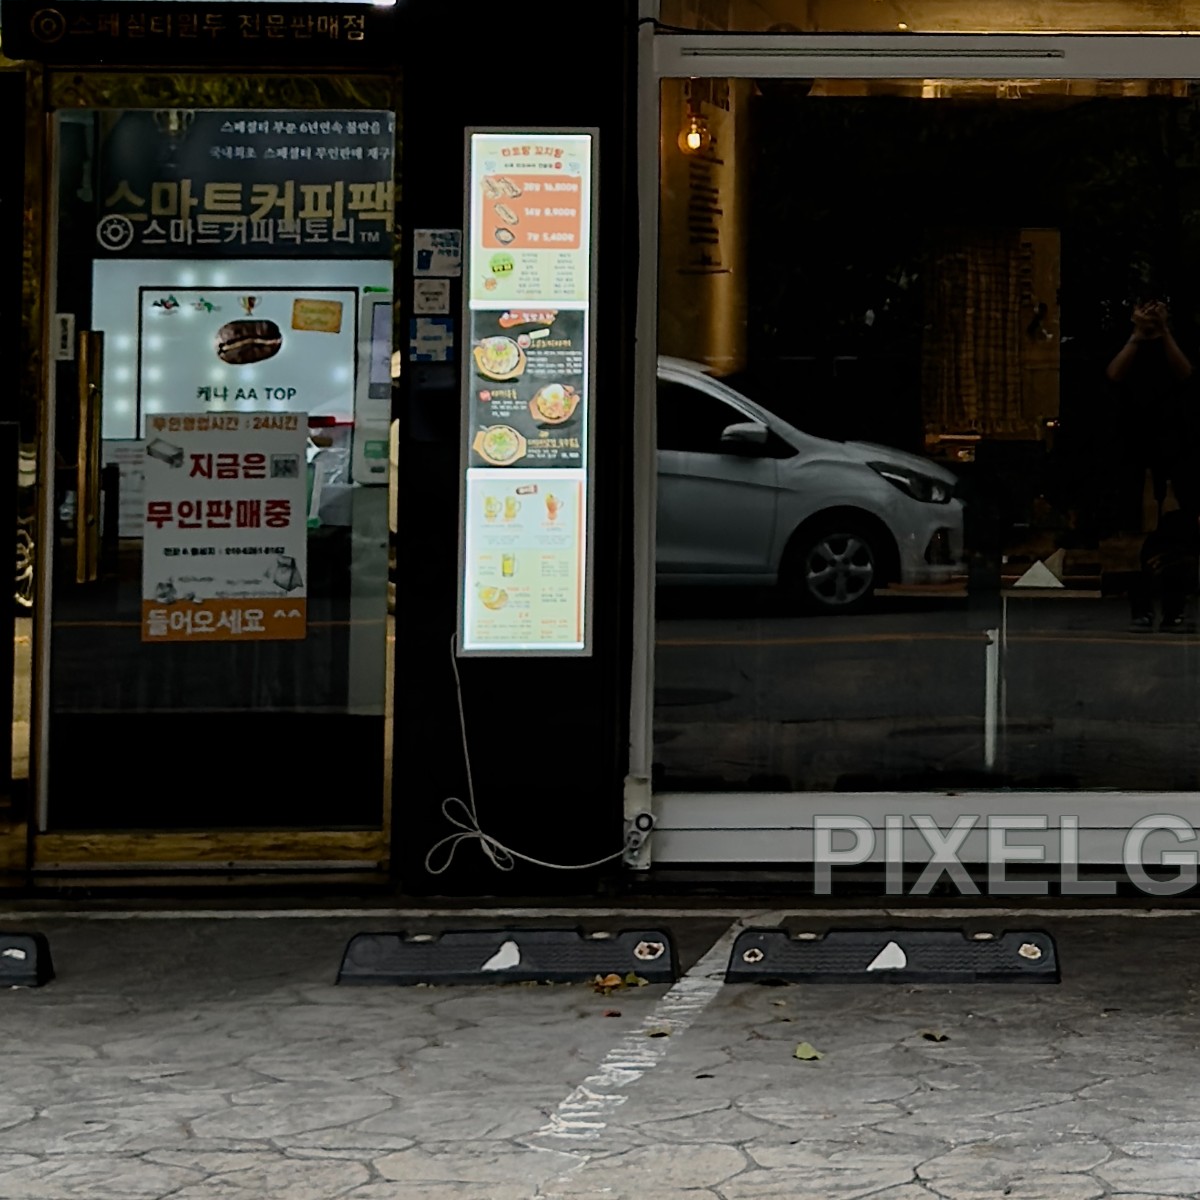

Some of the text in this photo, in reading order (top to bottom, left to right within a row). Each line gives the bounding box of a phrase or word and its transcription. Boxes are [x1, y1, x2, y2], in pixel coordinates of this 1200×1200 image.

[239, 13, 367, 40] 전문판매점
[104, 178, 395, 234] 스마트커피팩
[141, 217, 355, 245] 스마트커피팩토리
[234, 387, 257, 401] AA
[265, 387, 297, 401] TOP
[253, 416, 298, 431] 24시간
[189, 453, 266, 480] 지금은
[146, 499, 291, 529] 무인판매중
[146, 609, 266, 637] 들어오세요
